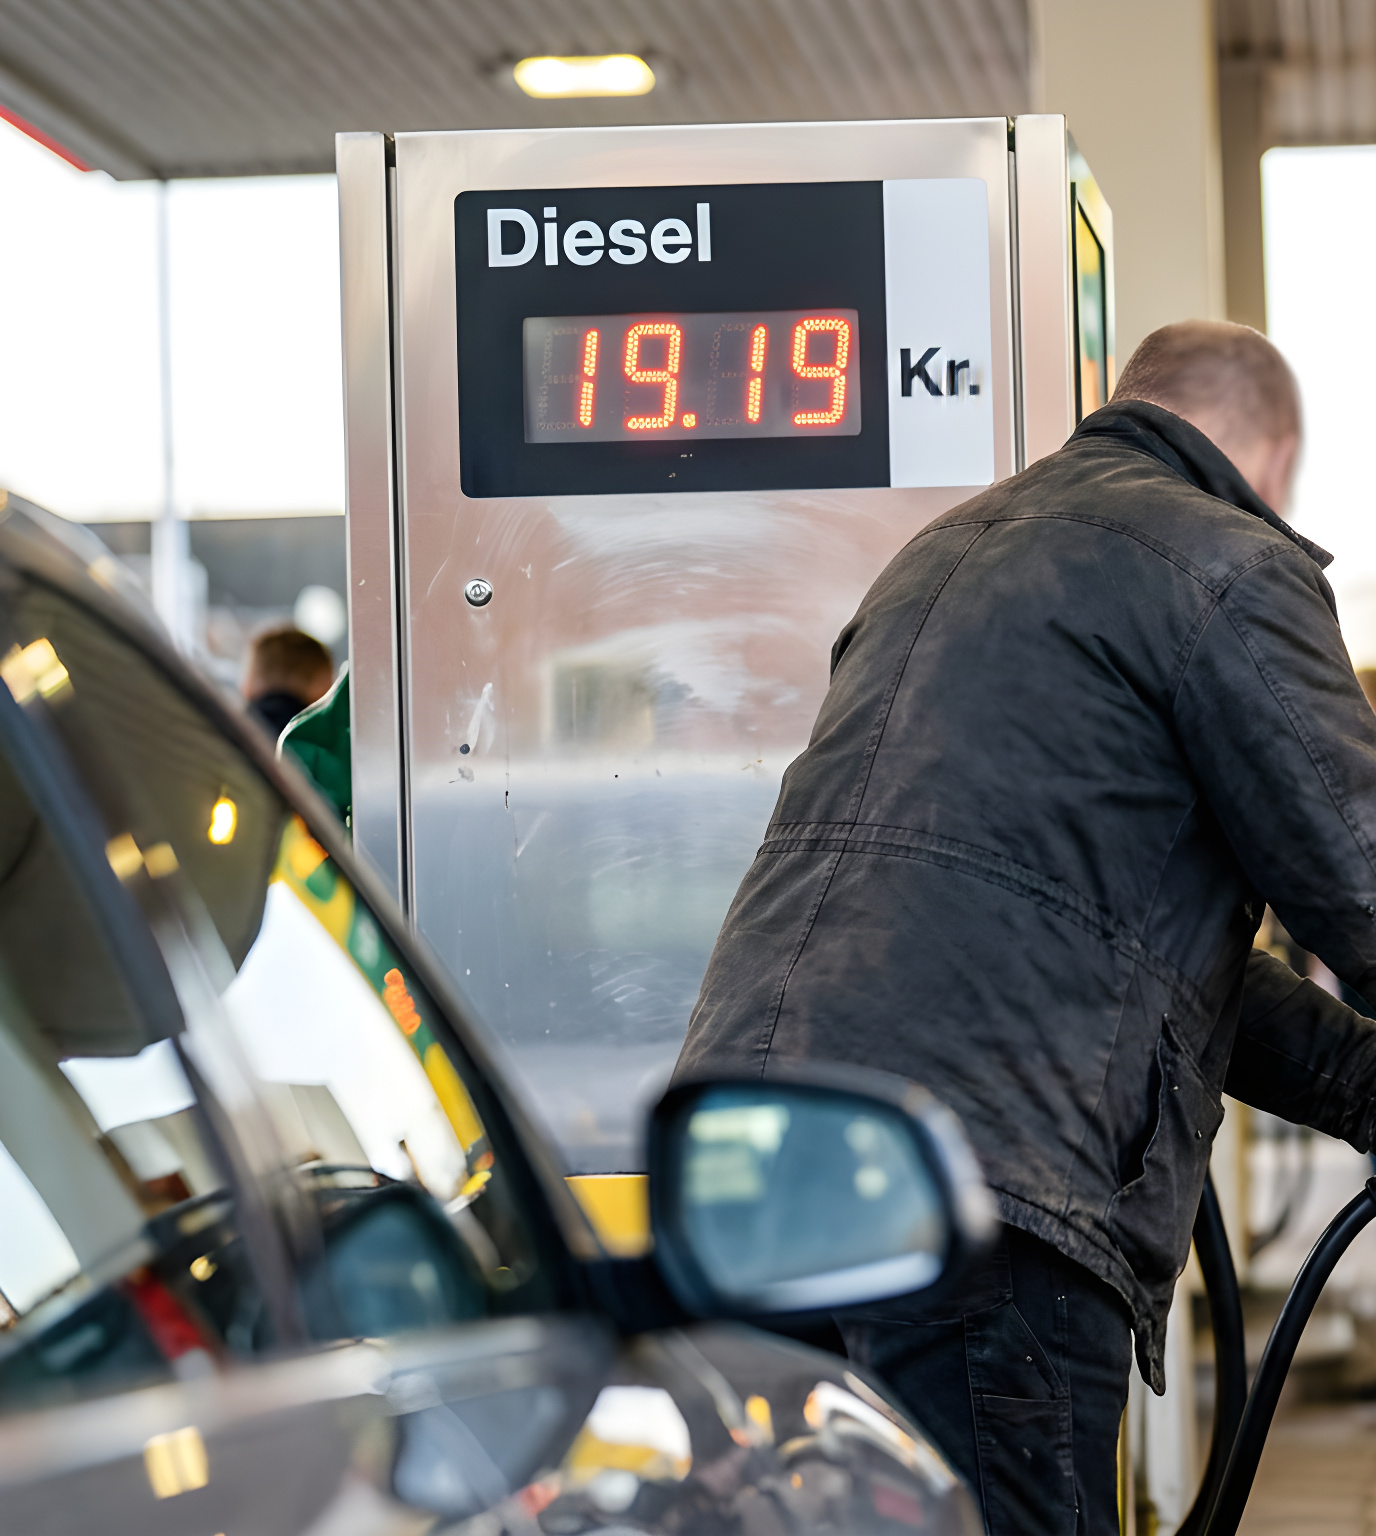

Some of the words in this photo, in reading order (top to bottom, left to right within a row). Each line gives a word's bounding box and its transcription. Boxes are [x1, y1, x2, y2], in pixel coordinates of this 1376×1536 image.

[486, 202, 712, 268] Diesel
[576, 316, 852, 431] 19.19
[900, 346, 980, 398] Kr.
